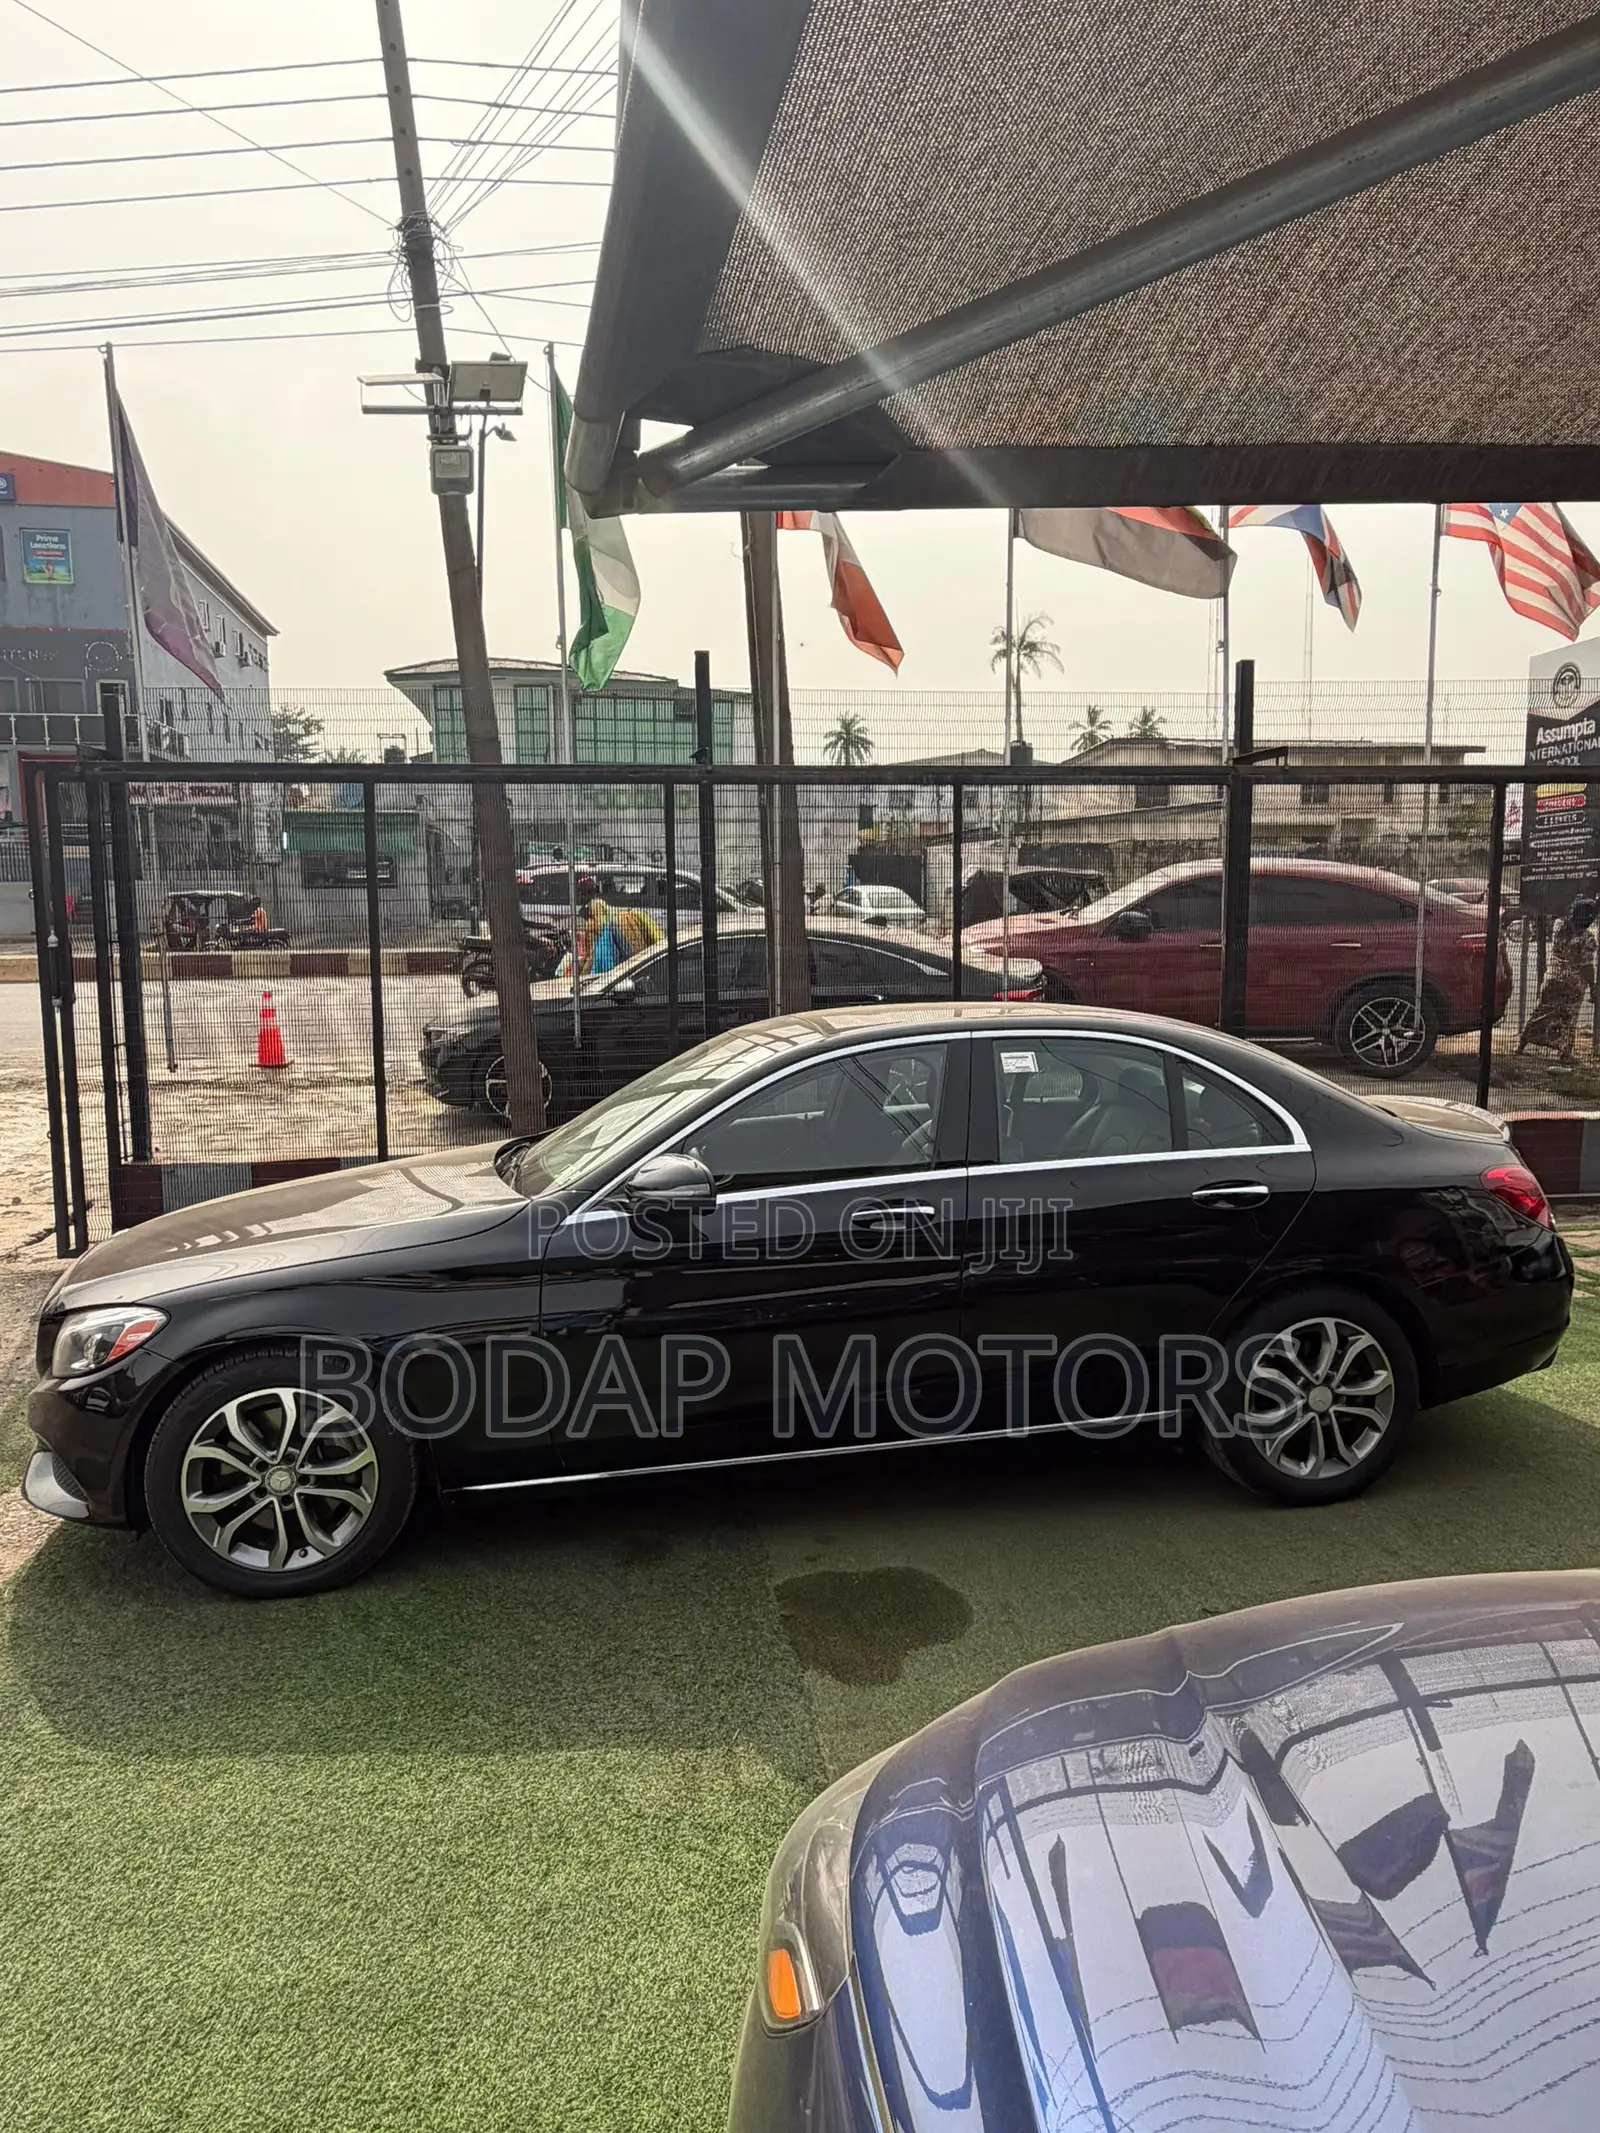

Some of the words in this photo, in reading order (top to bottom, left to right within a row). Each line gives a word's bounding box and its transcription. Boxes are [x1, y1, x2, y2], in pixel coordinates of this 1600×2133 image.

[29, 541, 66, 550] Locations
[35, 533, 59, 542] Prime
[1536, 717, 1596, 745] Assumpta
[1528, 736, 1600, 761] NTERNATIONA
